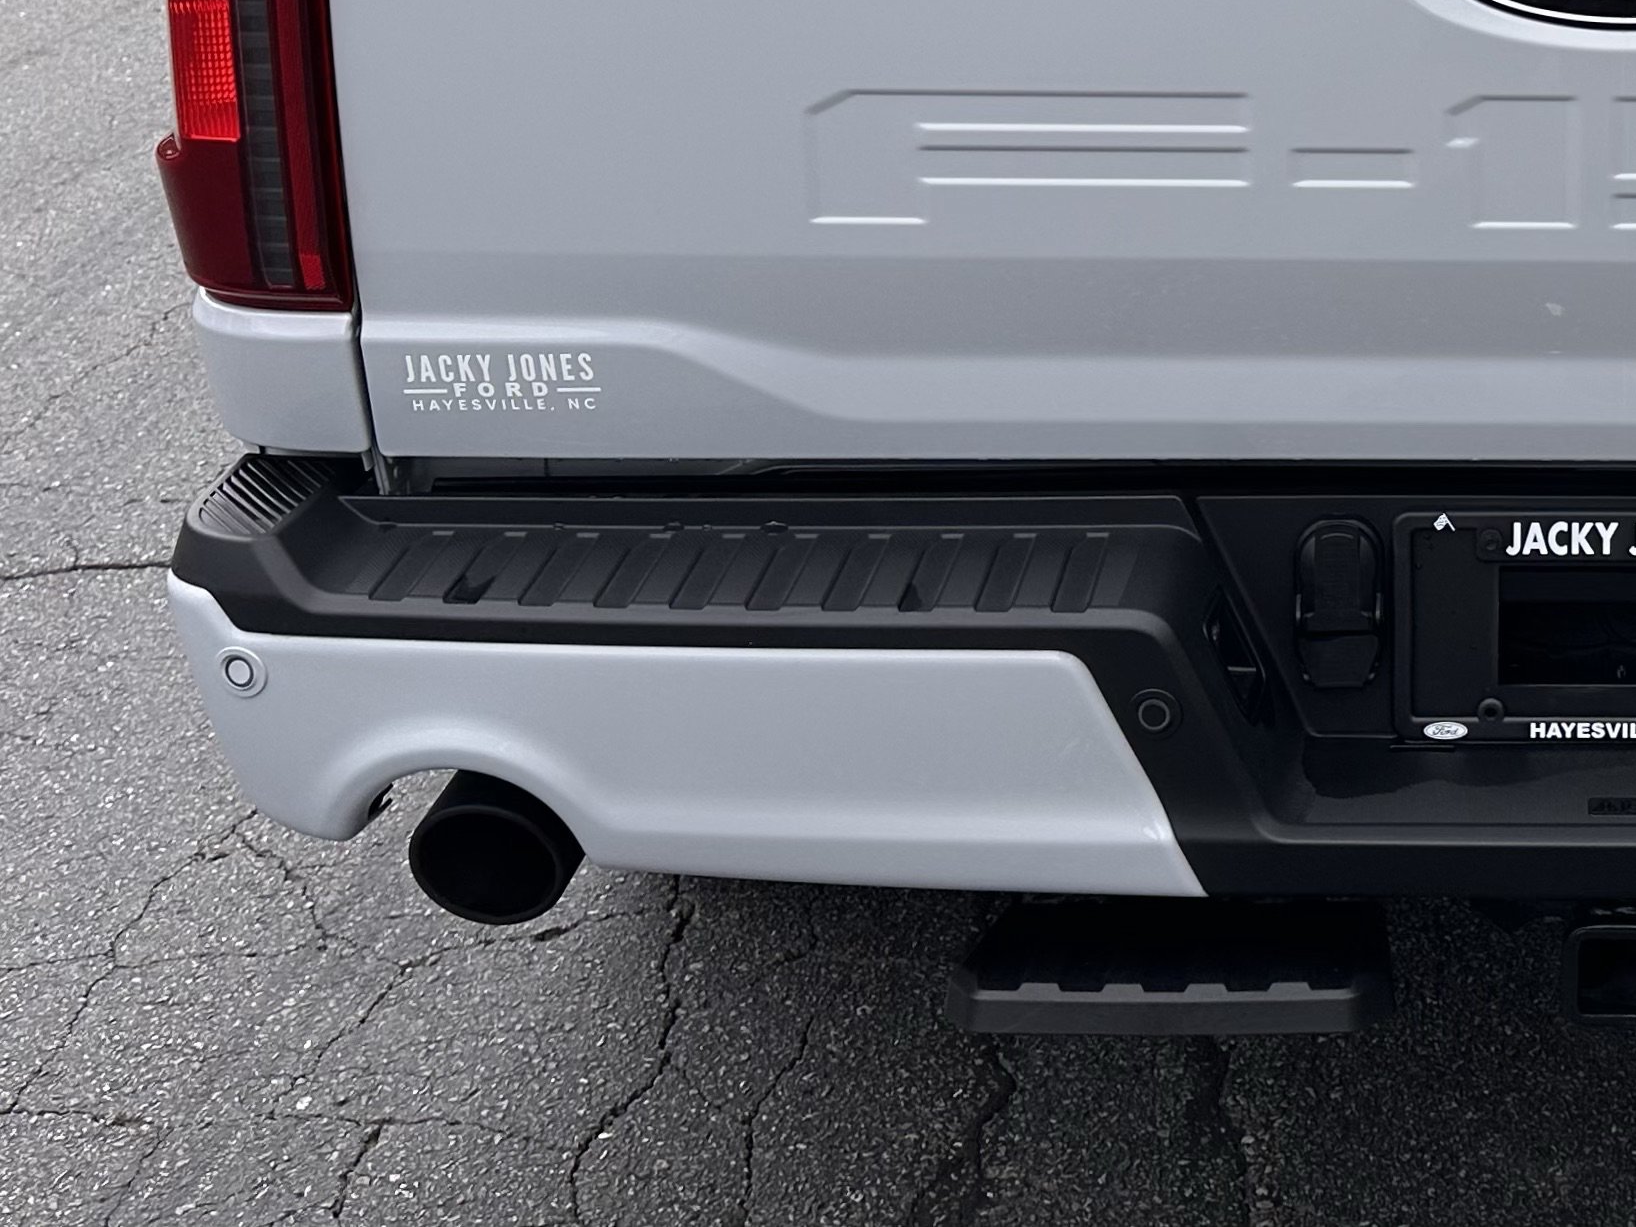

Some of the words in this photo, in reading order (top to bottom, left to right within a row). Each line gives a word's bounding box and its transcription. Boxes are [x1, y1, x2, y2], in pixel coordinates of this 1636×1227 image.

[404, 354, 491, 382] JACKY
[507, 353, 594, 381] JONES
[453, 382, 549, 397] FORD
[412, 399, 555, 411] HAYESVILLE,
[567, 397, 597, 410] NC
[1505, 521, 1619, 556] JACKY
